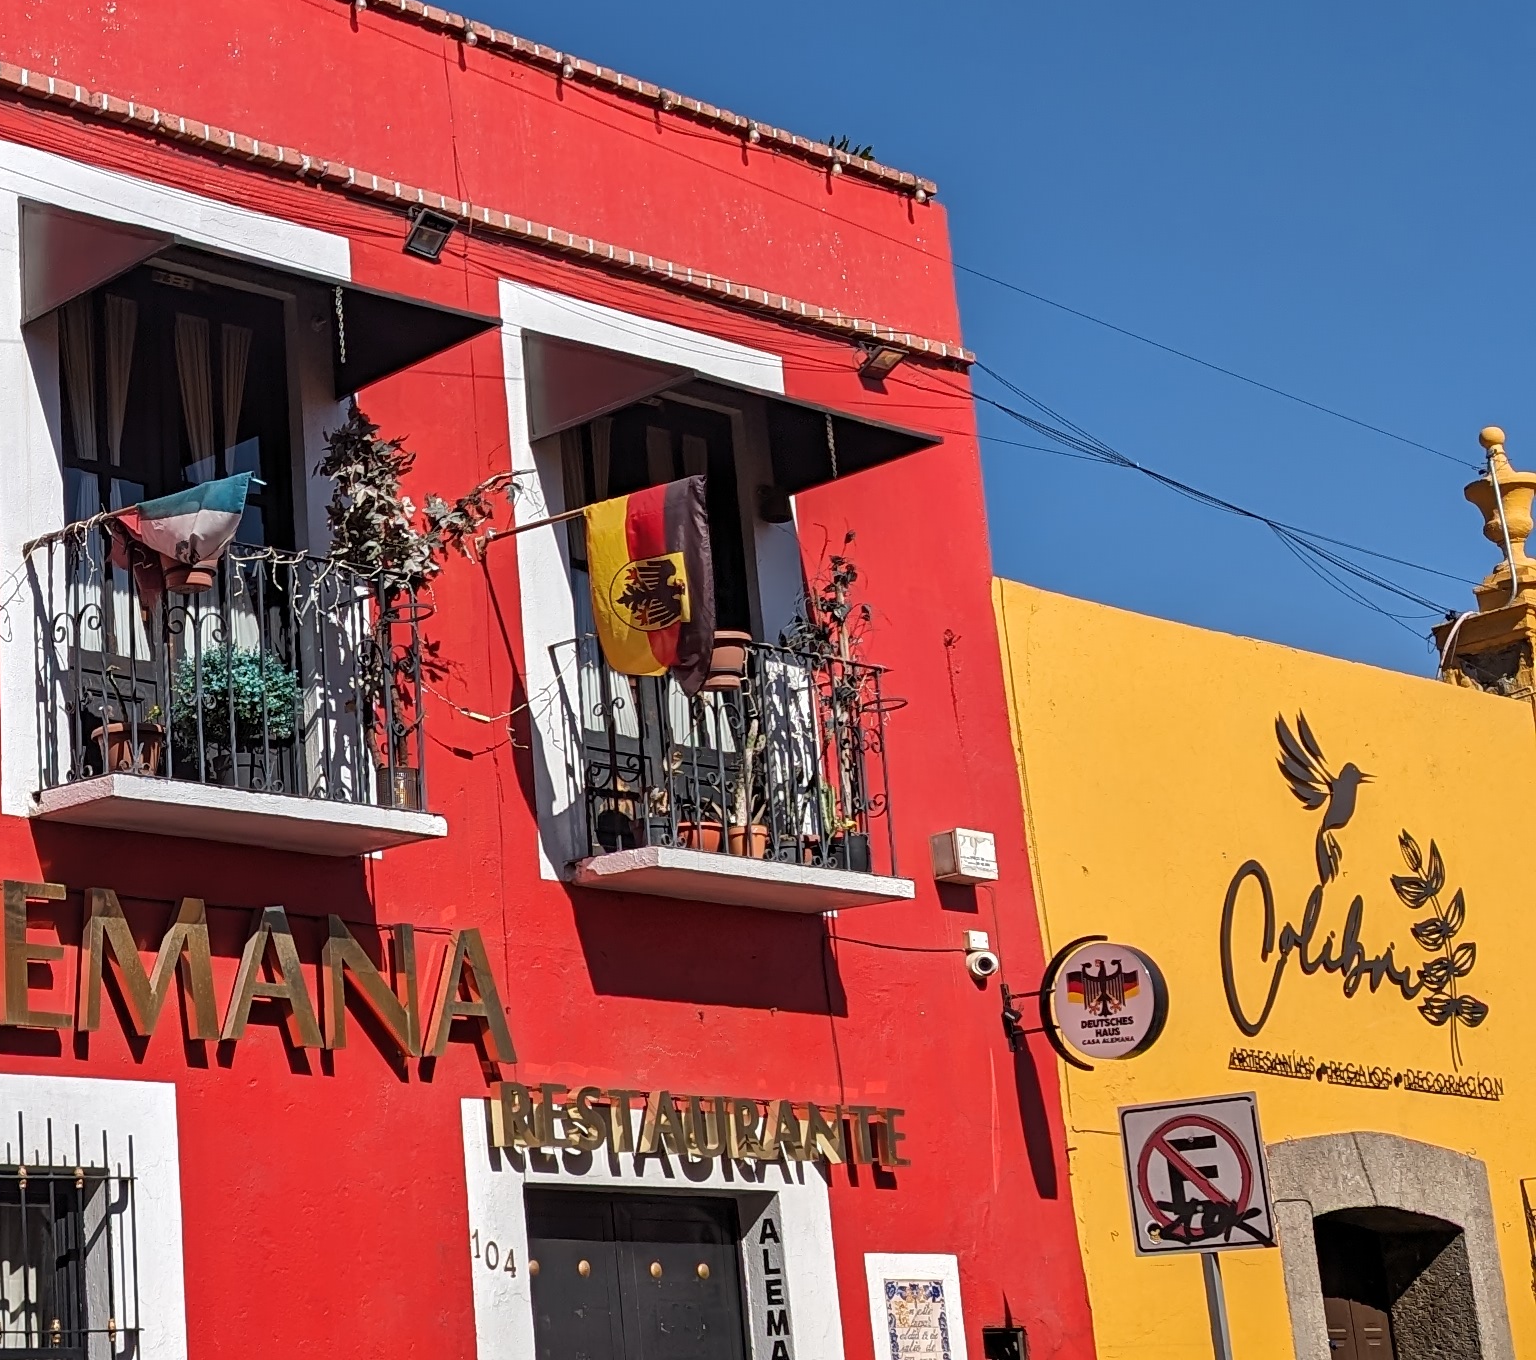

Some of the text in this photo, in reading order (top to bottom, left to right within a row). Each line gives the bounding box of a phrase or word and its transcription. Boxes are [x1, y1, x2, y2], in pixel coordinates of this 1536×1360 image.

[1081, 1016, 1134, 1029] DEUTSCHES
[1095, 1027, 1121, 1037] HAUS
[1102, 1036, 1135, 1044] ALEMANA
[491, 1081, 911, 1167] RESTAURANTE
[471, 1228, 517, 1278] 104
